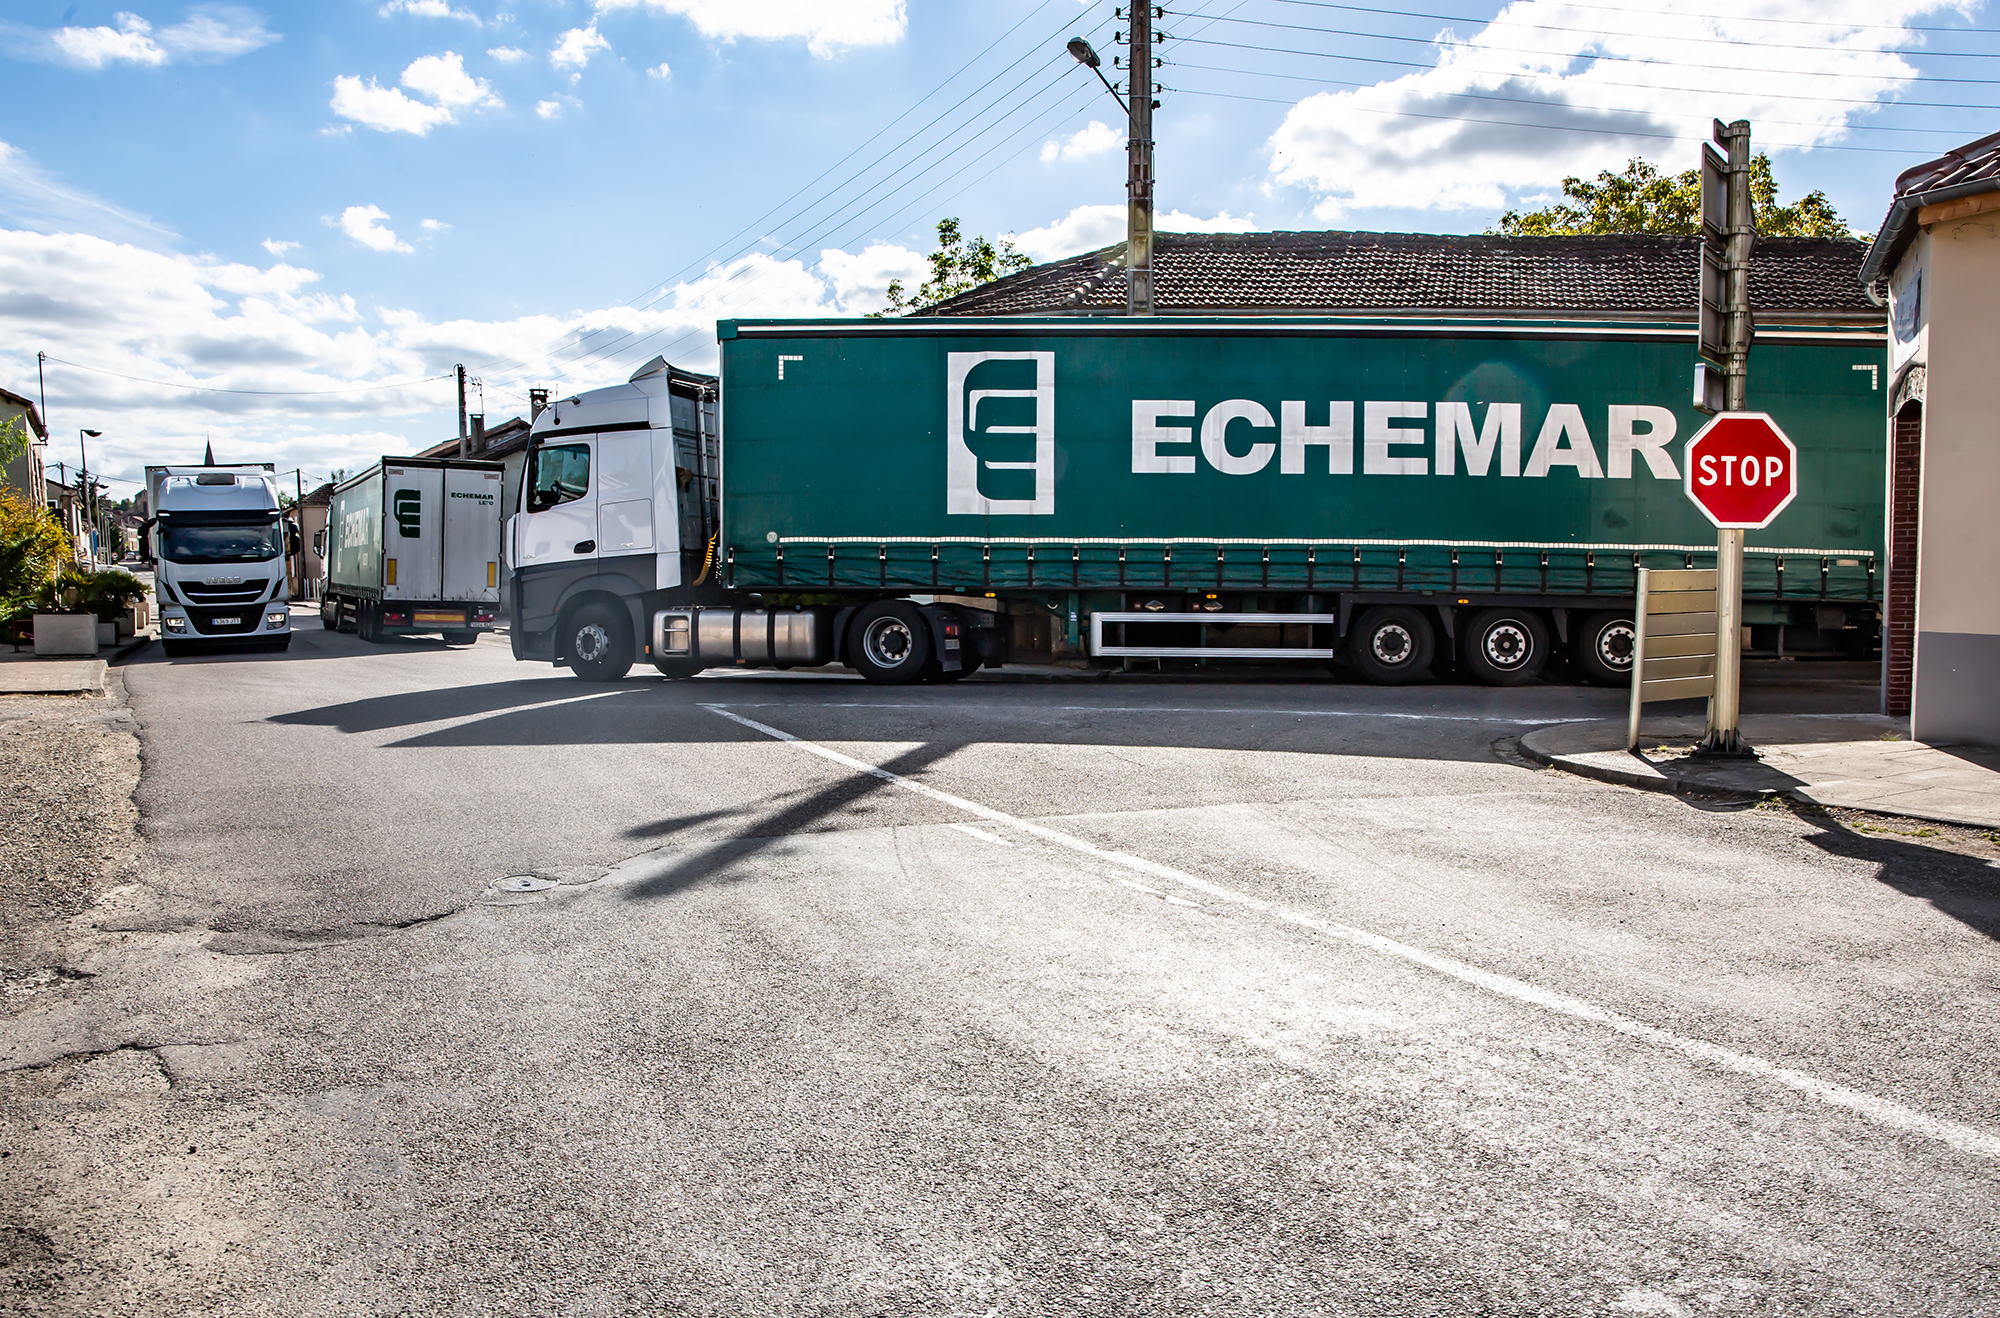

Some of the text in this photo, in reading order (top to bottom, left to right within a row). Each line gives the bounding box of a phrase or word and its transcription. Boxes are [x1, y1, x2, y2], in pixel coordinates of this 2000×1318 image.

[1131, 398, 1682, 480] ECHEMAR
[1698, 453, 1785, 487] STOP
[451, 492, 493, 500] ECHEMAR
[207, 576, 241, 584] IVECO
